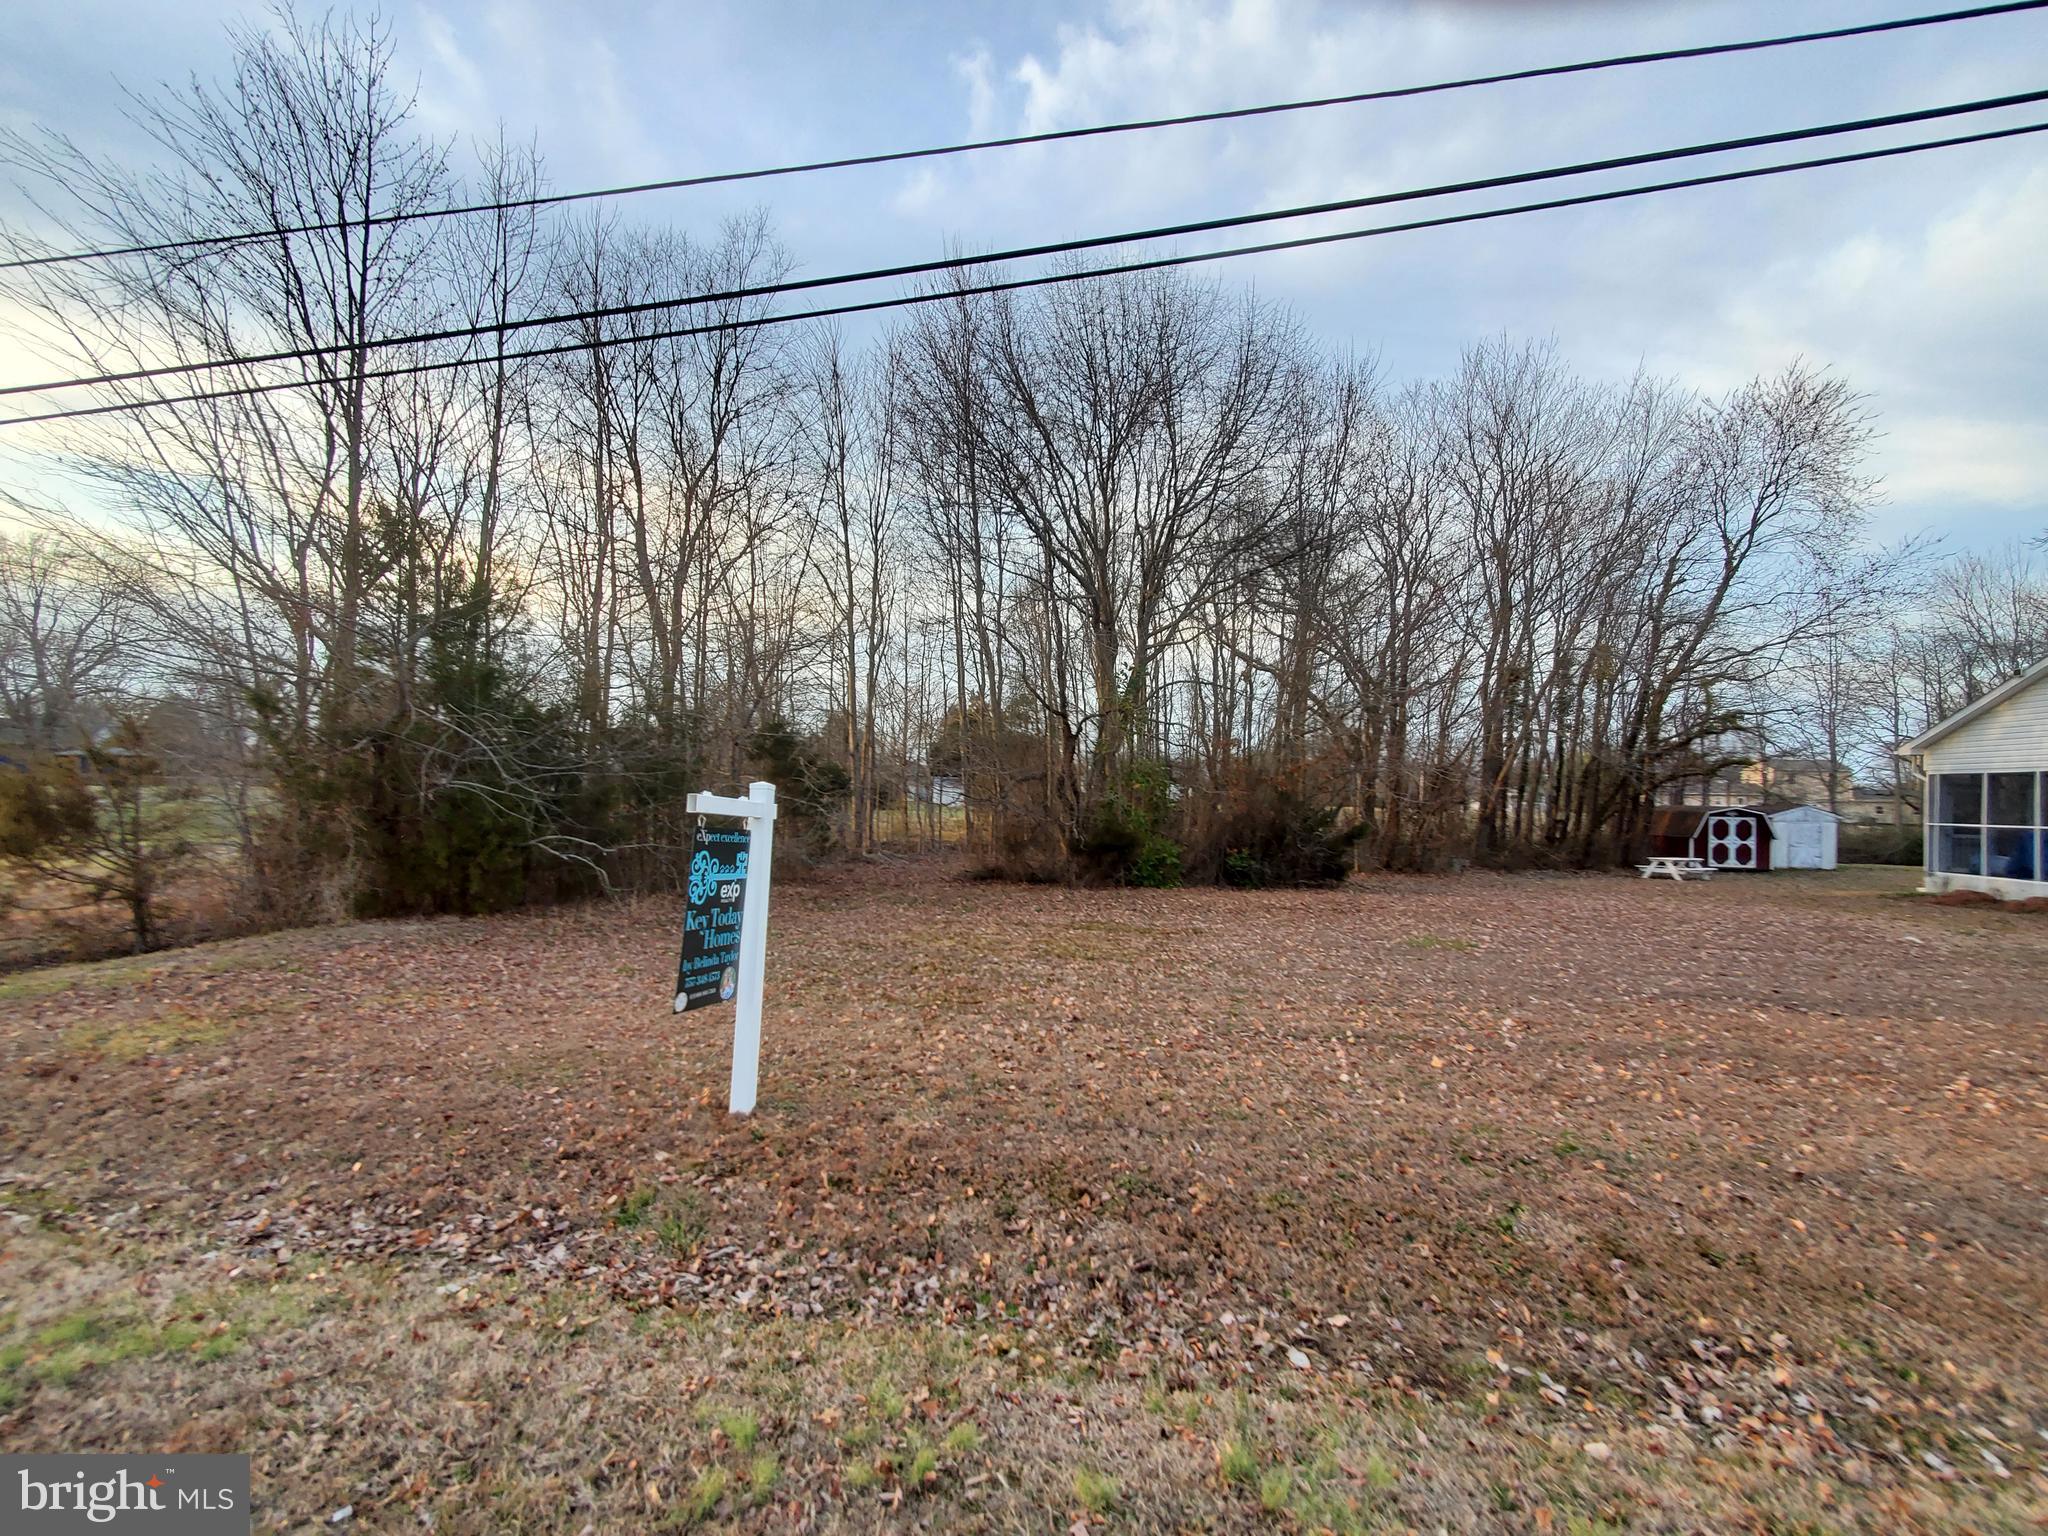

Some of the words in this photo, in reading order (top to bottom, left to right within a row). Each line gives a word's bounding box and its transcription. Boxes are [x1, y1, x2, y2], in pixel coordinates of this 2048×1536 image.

[685, 910, 709, 934] Key
[711, 906, 744, 929] Today
[703, 928, 740, 949] Homes
